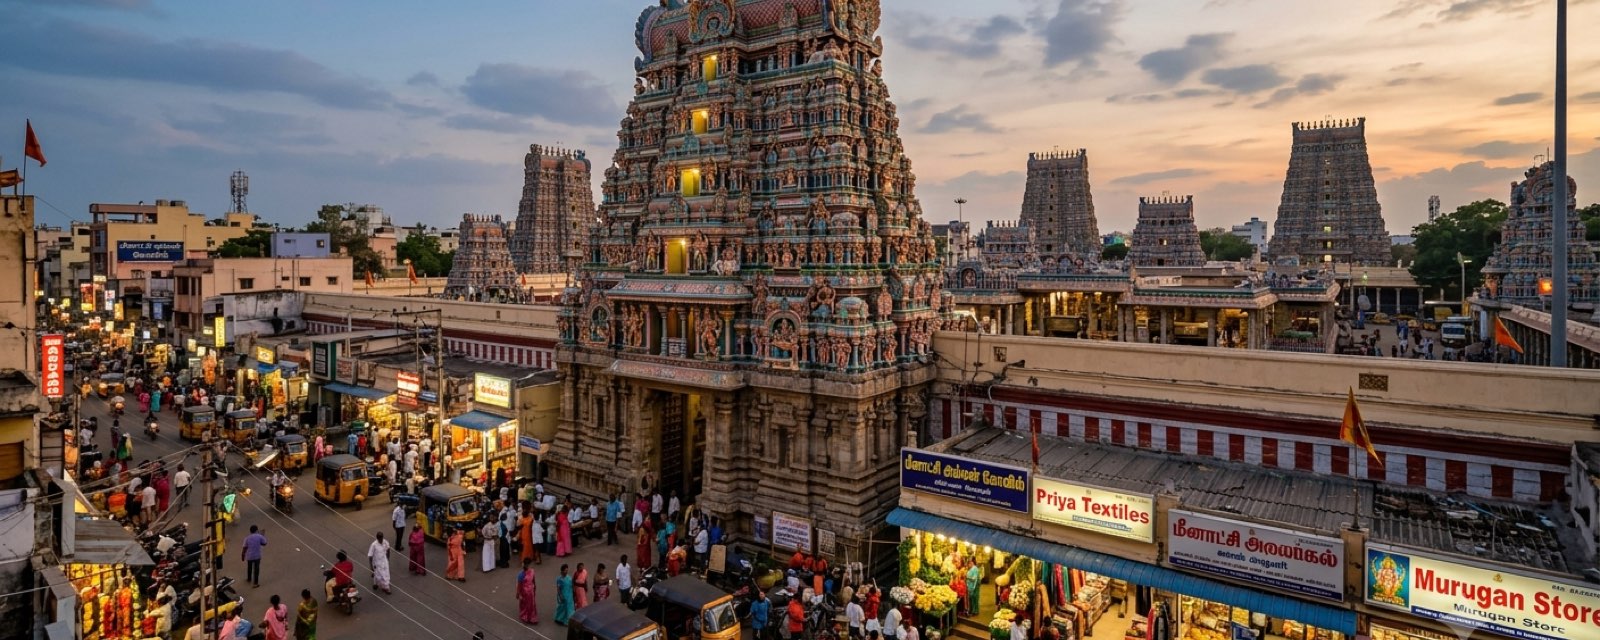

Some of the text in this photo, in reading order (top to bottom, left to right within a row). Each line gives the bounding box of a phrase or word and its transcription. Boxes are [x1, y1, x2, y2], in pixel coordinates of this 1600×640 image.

[1036, 488, 1076, 511] Priya
[1081, 496, 1150, 524] Textiles
[1414, 567, 1525, 609] Murugan
